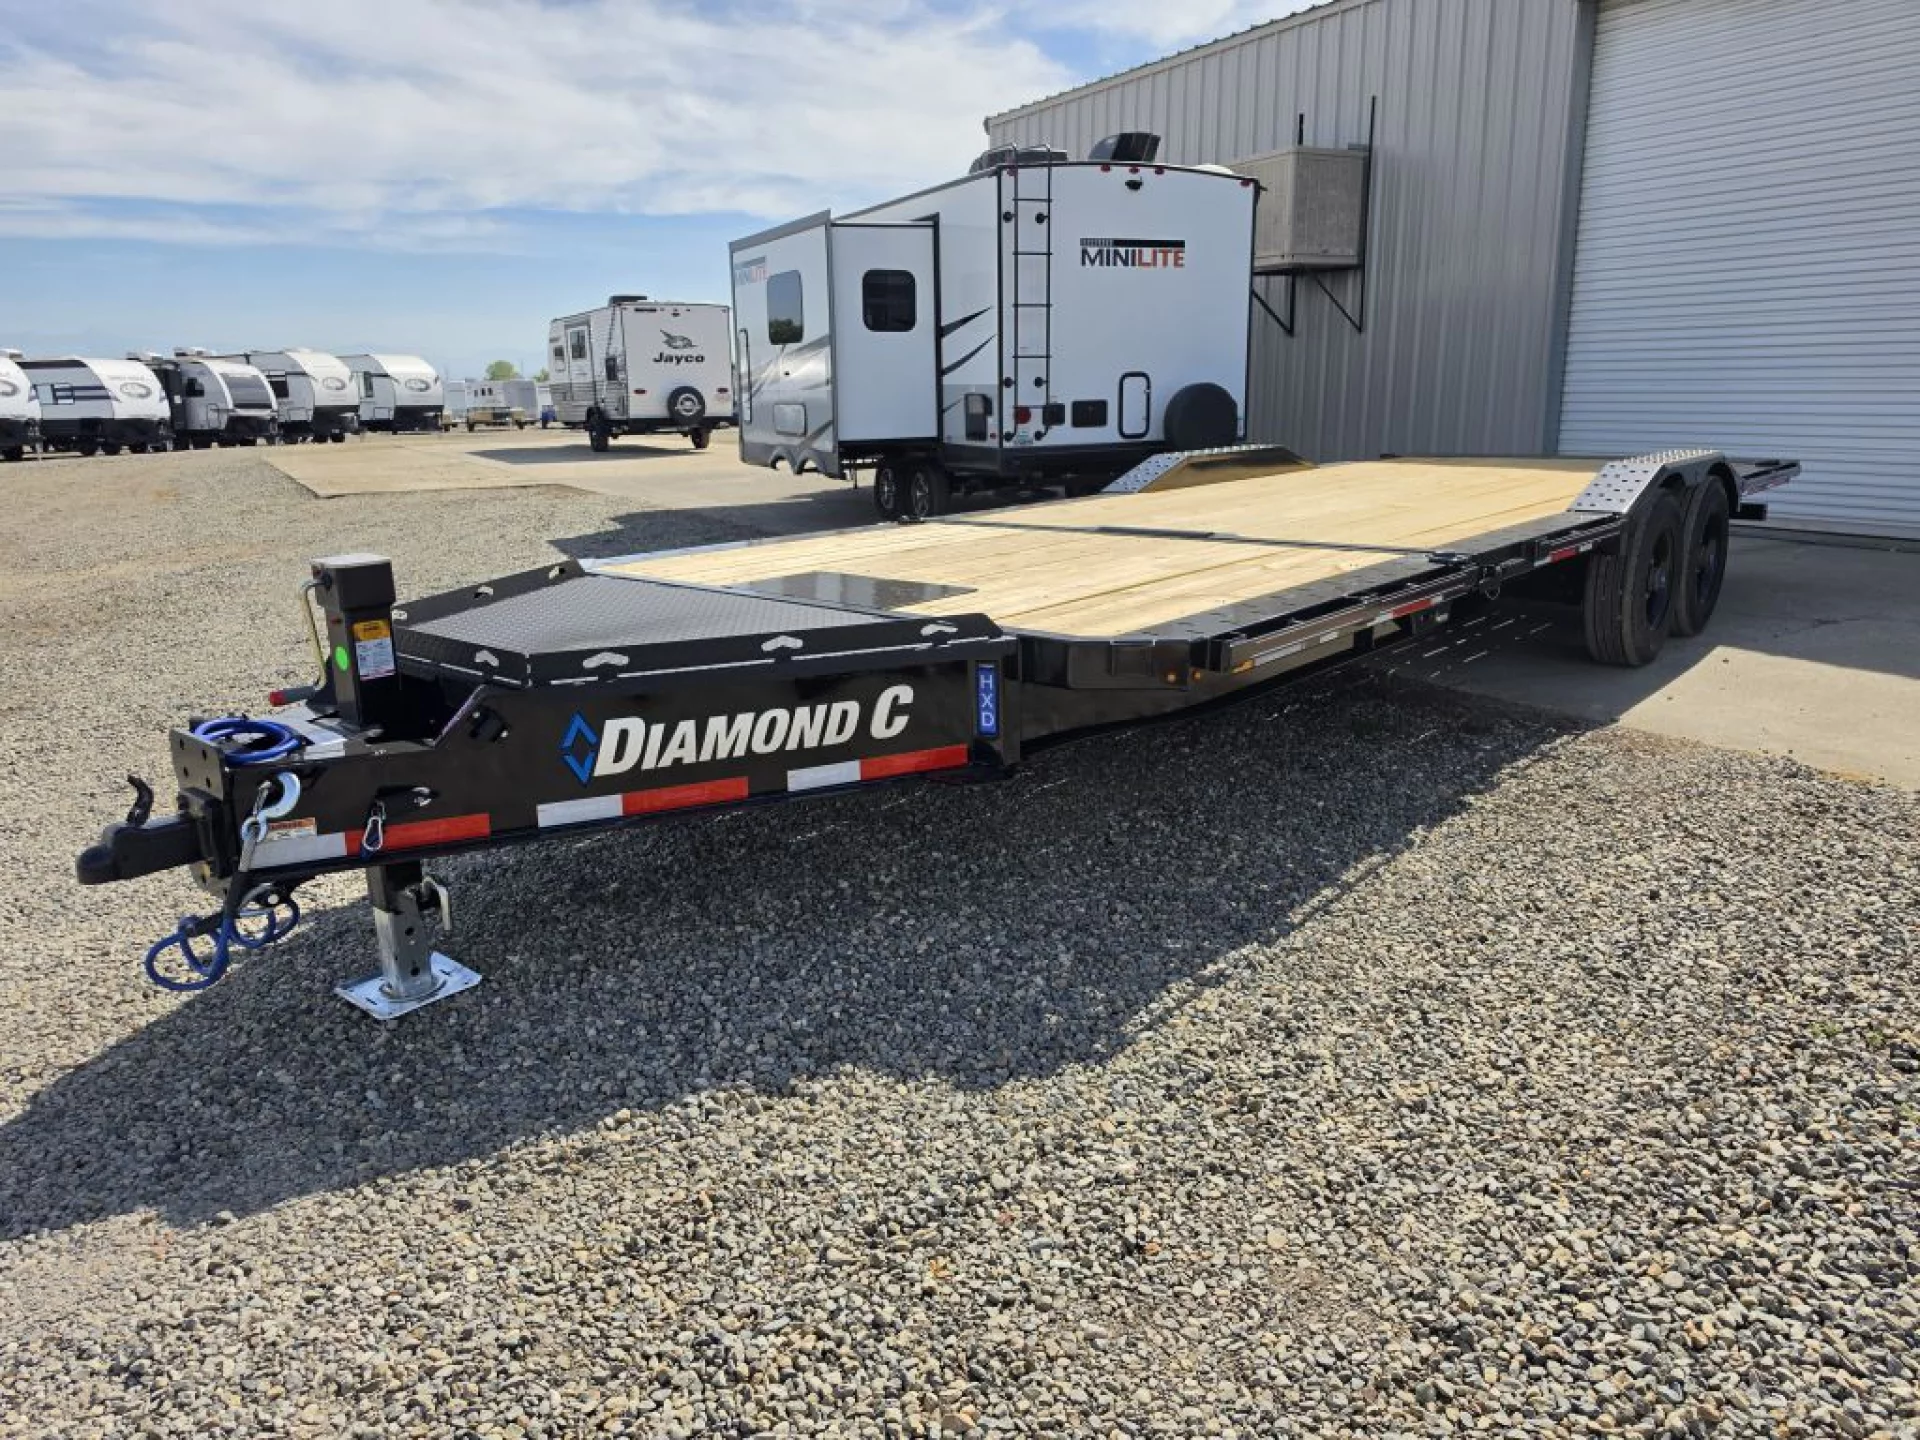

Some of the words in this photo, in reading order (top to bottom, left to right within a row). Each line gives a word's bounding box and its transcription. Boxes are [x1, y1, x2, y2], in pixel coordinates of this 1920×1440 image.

[1081, 248, 1185, 267] MINILITE
[652, 352, 705, 366] Jayco
[980, 675, 994, 726] HXD
[594, 701, 860, 777] DIAMOND
[870, 685, 914, 740] C
